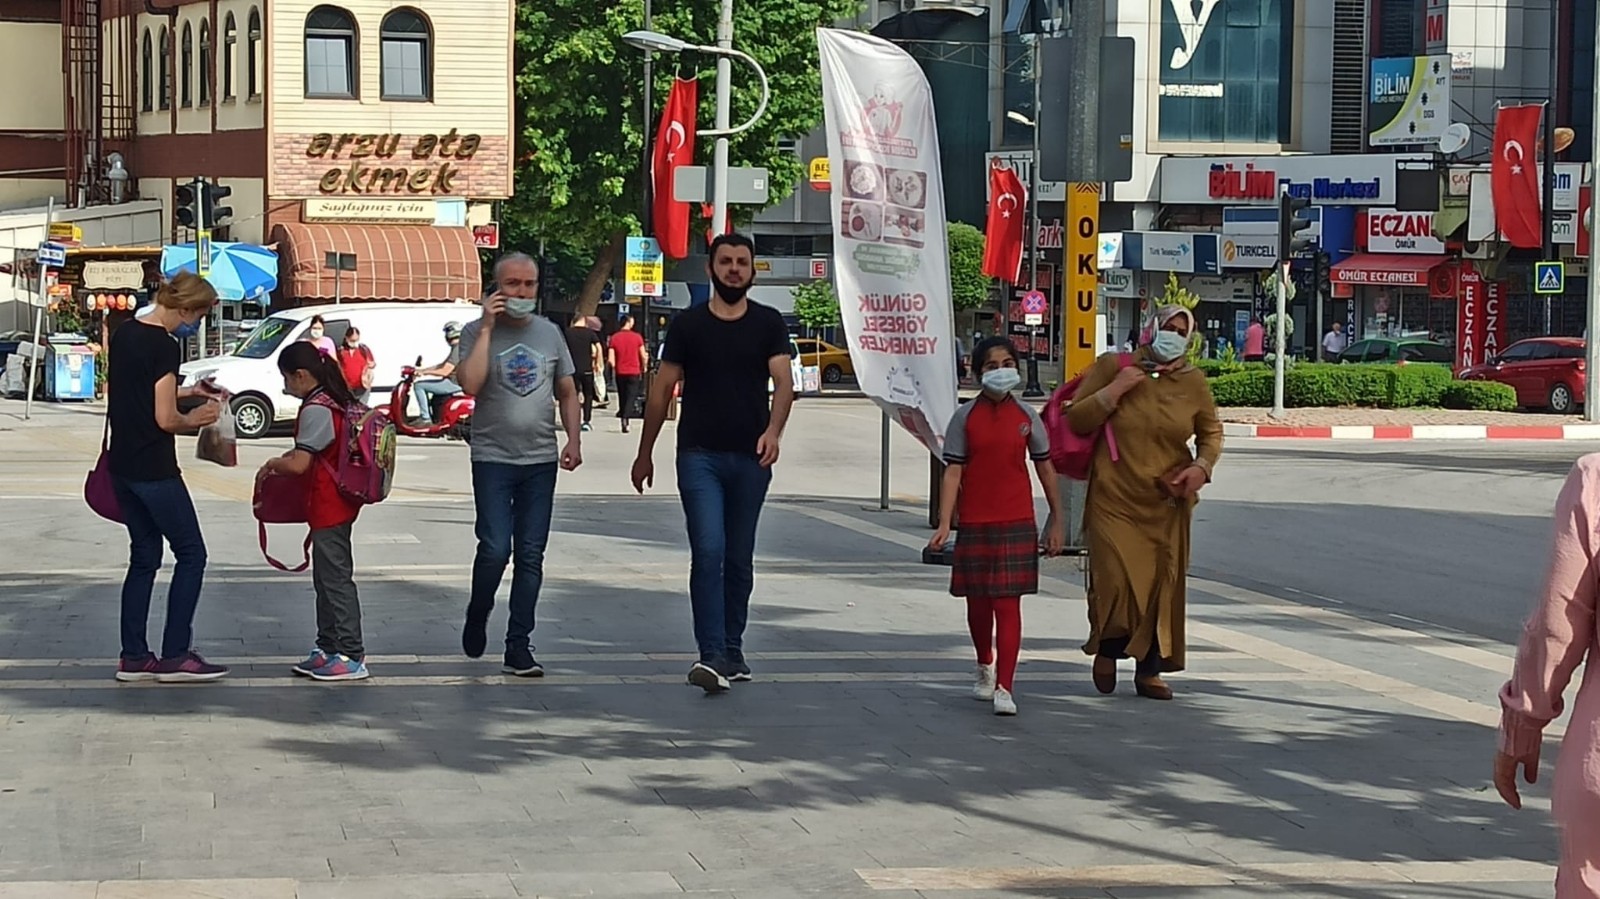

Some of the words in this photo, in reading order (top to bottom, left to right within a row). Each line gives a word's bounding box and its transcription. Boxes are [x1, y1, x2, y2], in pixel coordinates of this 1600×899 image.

[1374, 72, 1410, 96] BİLİM
[306, 132, 402, 160] arzu
[411, 127, 482, 160] ata
[318, 160, 459, 194] ekmek
[1209, 163, 1276, 199] BİLİM
[1314, 177, 1380, 198] Merkezi
[1037, 218, 1064, 248] ark
[1370, 214, 1436, 237] ECZAN
[1236, 245, 1276, 258] TURKCELL
[1395, 238, 1416, 249] ÖMÜR
[1078, 216, 1095, 349] OKUL
[1338, 269, 1368, 281] ÖMÜR
[1370, 270, 1417, 283] ECZANESİ
